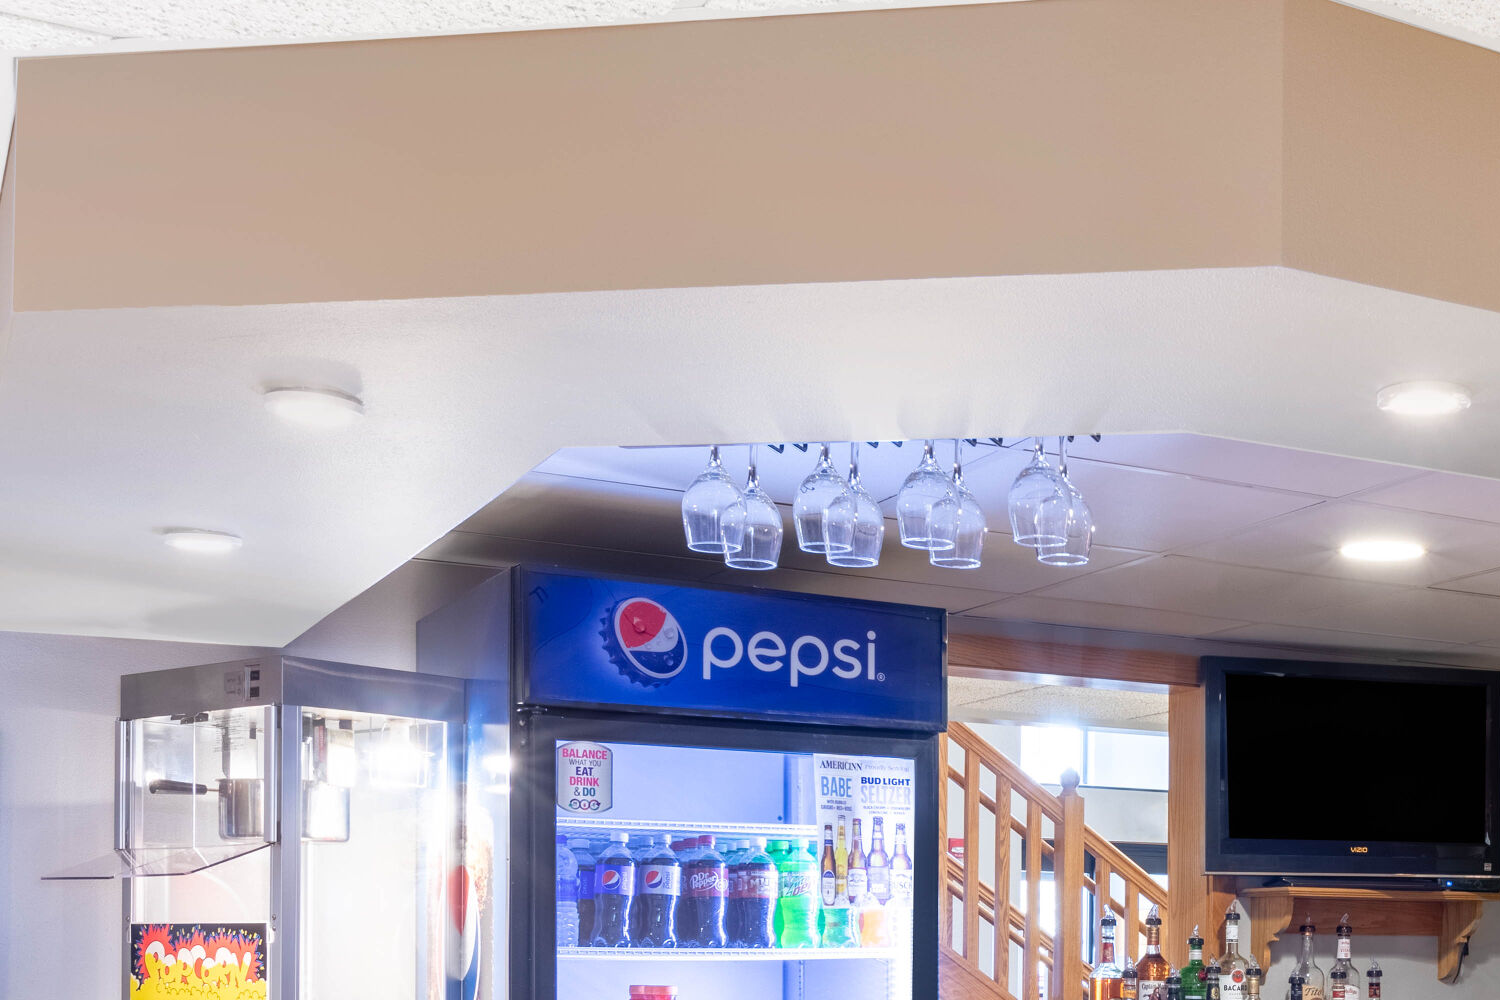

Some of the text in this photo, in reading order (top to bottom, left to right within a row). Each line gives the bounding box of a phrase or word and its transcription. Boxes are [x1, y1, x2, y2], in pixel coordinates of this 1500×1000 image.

[703, 626, 876, 688] pepsi
[562, 748, 608, 760] BALANCE
[569, 758, 602, 768] WHAT YOU
[575, 766, 594, 777] EAT
[569, 776, 600, 787] DRINK
[861, 776, 911, 786] BUD LIGHT
[573, 786, 596, 797] & DO
[820, 776, 853, 798] BABE
[860, 785, 911, 806] SELTZER
[690, 874, 719, 889] Pepper
[698, 872, 710, 881] Dr
[145, 941, 252, 987] POPCORN
